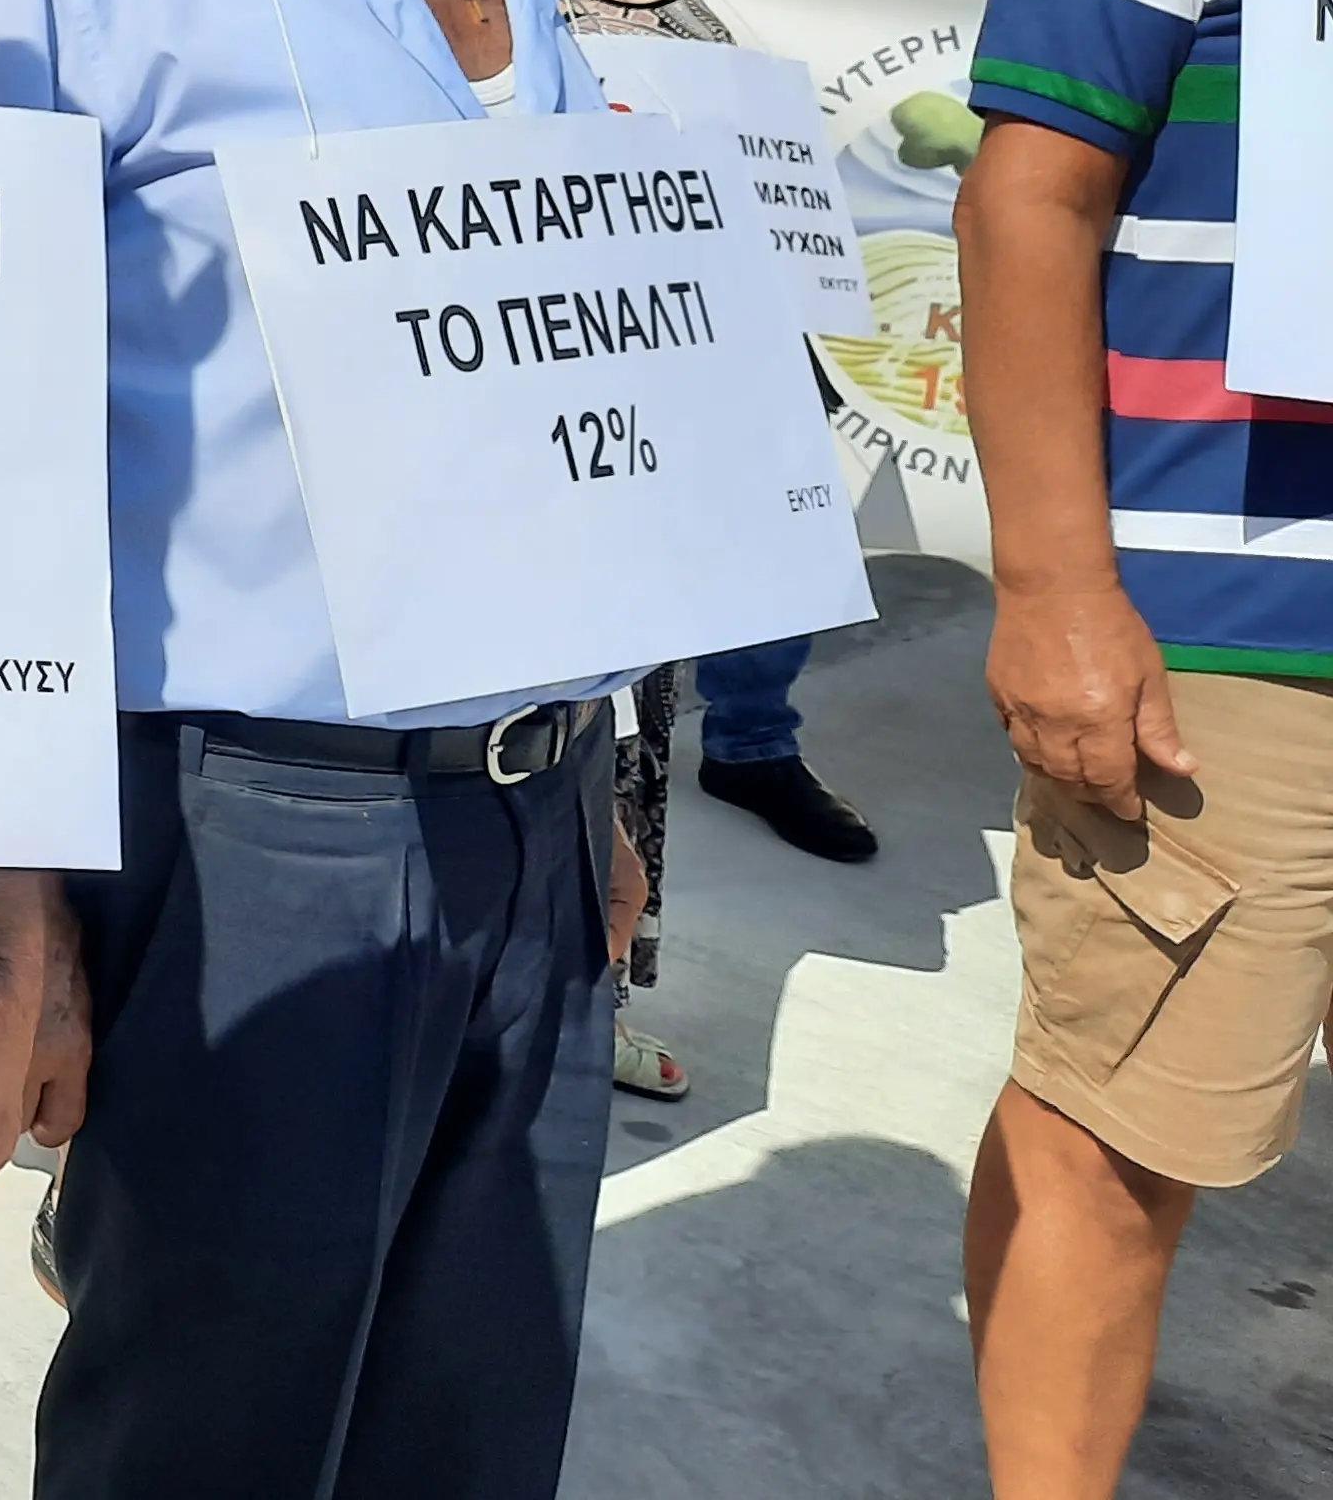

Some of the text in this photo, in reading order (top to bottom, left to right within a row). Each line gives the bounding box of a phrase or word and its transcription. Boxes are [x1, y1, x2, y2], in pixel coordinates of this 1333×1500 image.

[820, 24, 961, 115] ΥΤΕΡΗ
[299, 169, 724, 265] ΝΑ ΚΑΤΑΡΓΗΘΕΙ
[753, 180, 832, 211] ΜΑΤΩΝ
[769, 228, 845, 258] ΥΧΩΝ
[395, 281, 714, 377] ΤΟ ΠΕΝΑΛΤΙ
[551, 405, 657, 482] 12%
[831, 405, 971, 485] ΠΡΙΩΝ
[786, 485, 830, 513] ΕΚΥΣΥ
